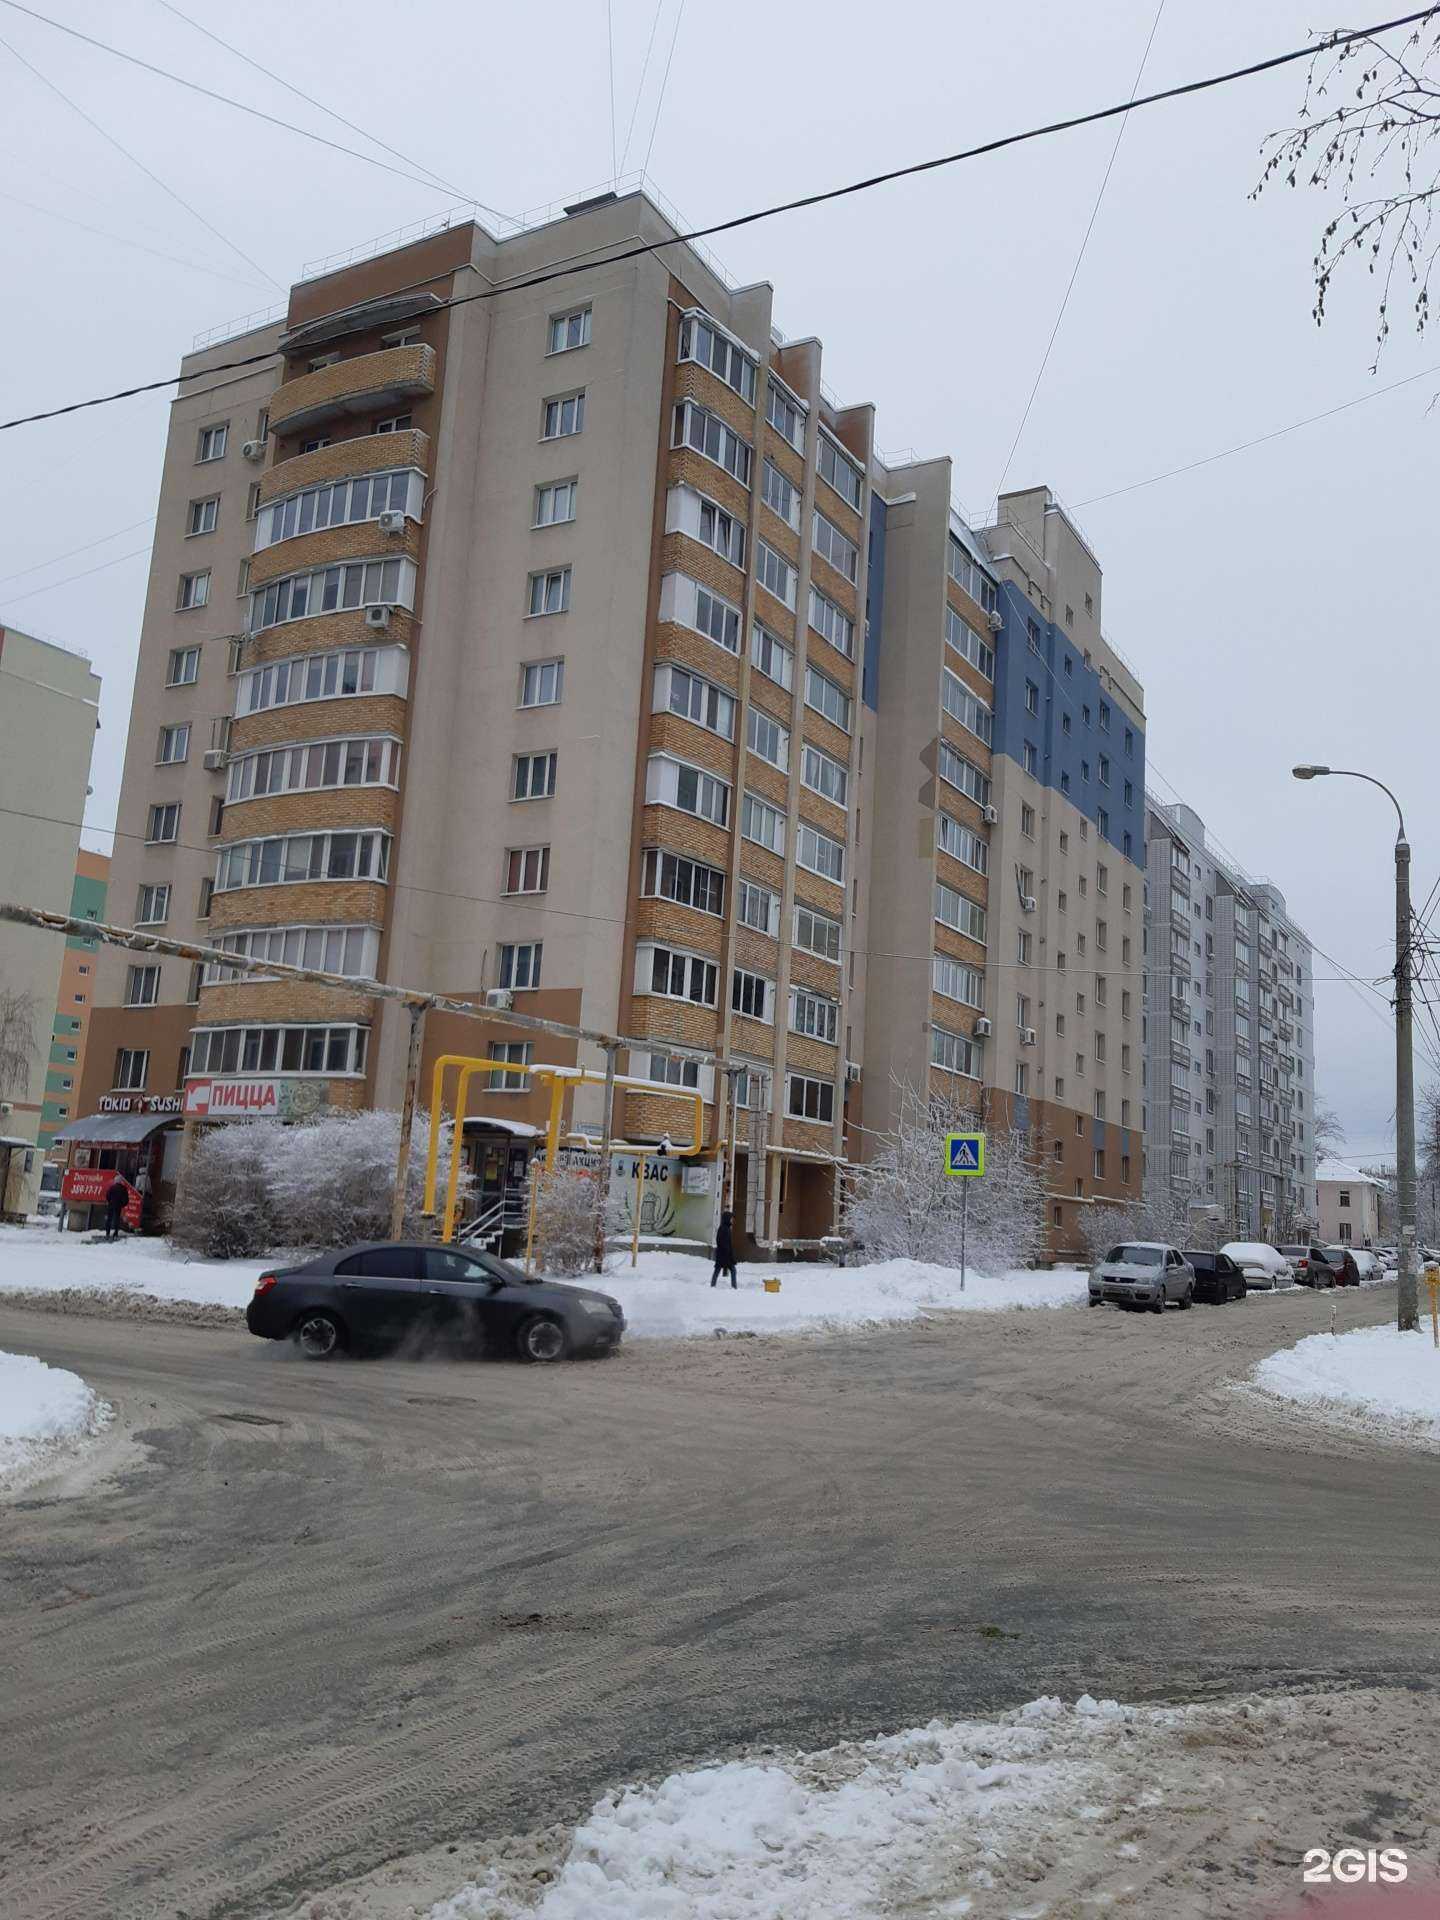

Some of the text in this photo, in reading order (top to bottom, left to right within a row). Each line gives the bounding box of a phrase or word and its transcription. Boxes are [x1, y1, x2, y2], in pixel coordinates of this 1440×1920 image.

[150, 1096, 183, 1112] SUSHI
[212, 1085, 276, 1110] ПИЦЦА
[631, 1161, 669, 1182] КВАС
